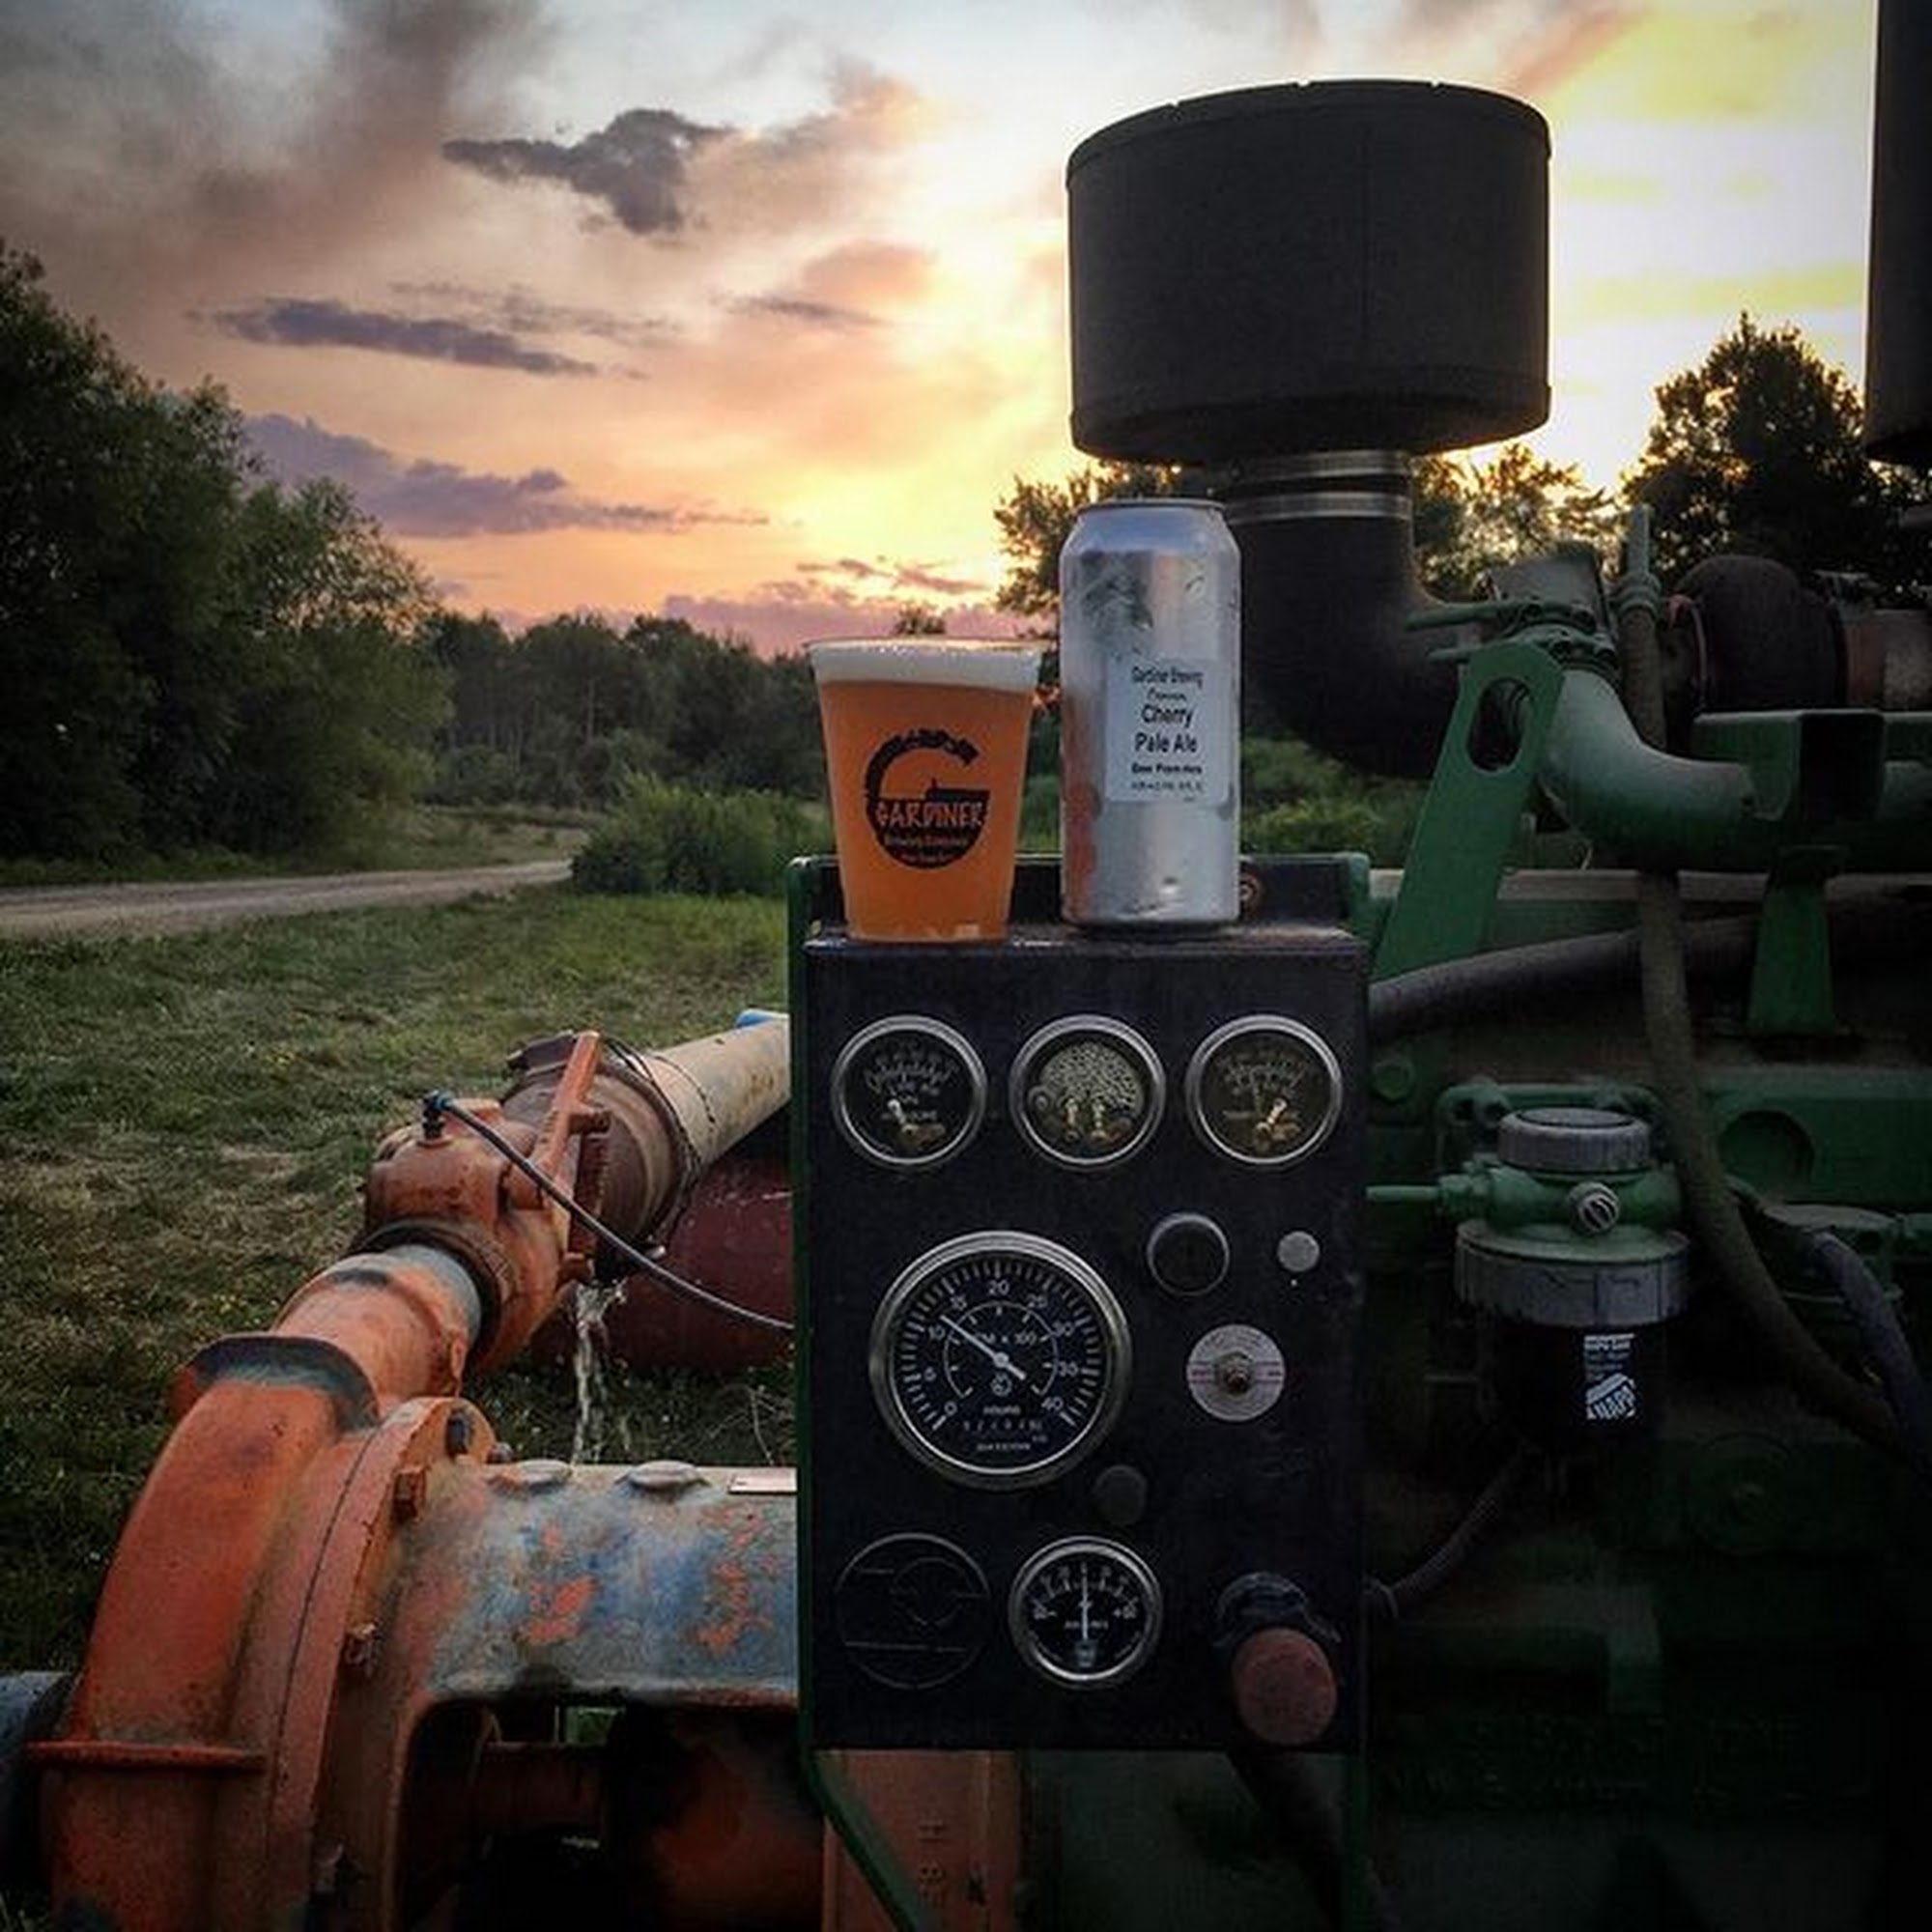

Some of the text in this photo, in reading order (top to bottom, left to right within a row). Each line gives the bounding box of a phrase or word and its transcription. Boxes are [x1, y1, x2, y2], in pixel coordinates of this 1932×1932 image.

[1141, 704, 1193, 728] Cherry
[1135, 732, 1198, 753] Pale Ale
[876, 801, 983, 827] GARDINER
[989, 1279, 1009, 1295] 20
[945, 1402, 956, 1415] 0
